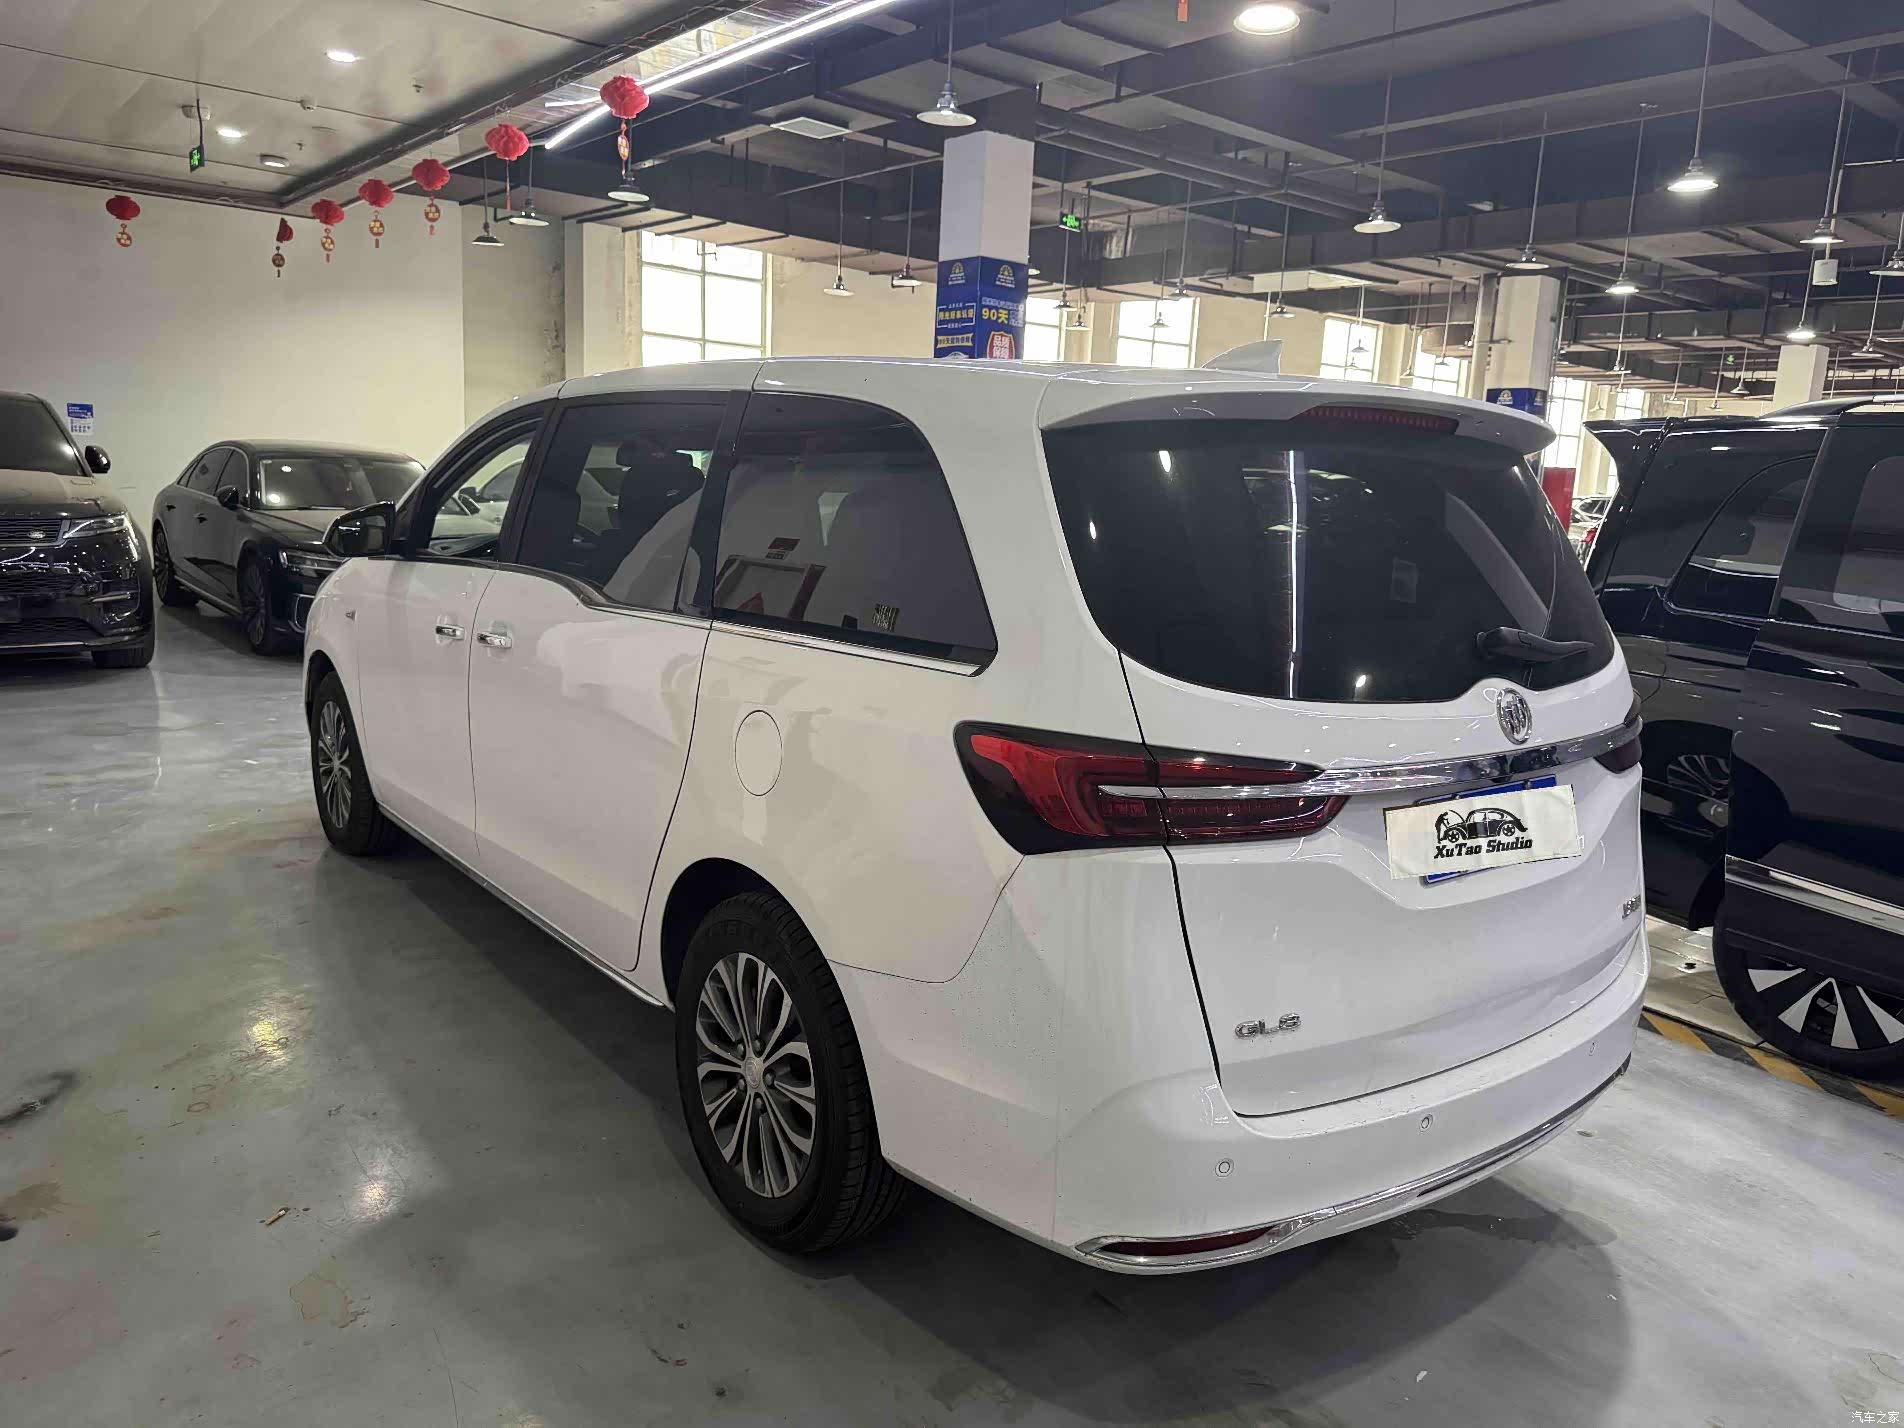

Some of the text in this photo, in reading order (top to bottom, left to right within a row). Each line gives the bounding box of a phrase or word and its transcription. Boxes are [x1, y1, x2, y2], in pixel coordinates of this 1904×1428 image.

[982, 308, 1009, 324] 90天
[1433, 836, 1533, 859] XuTao Studio
